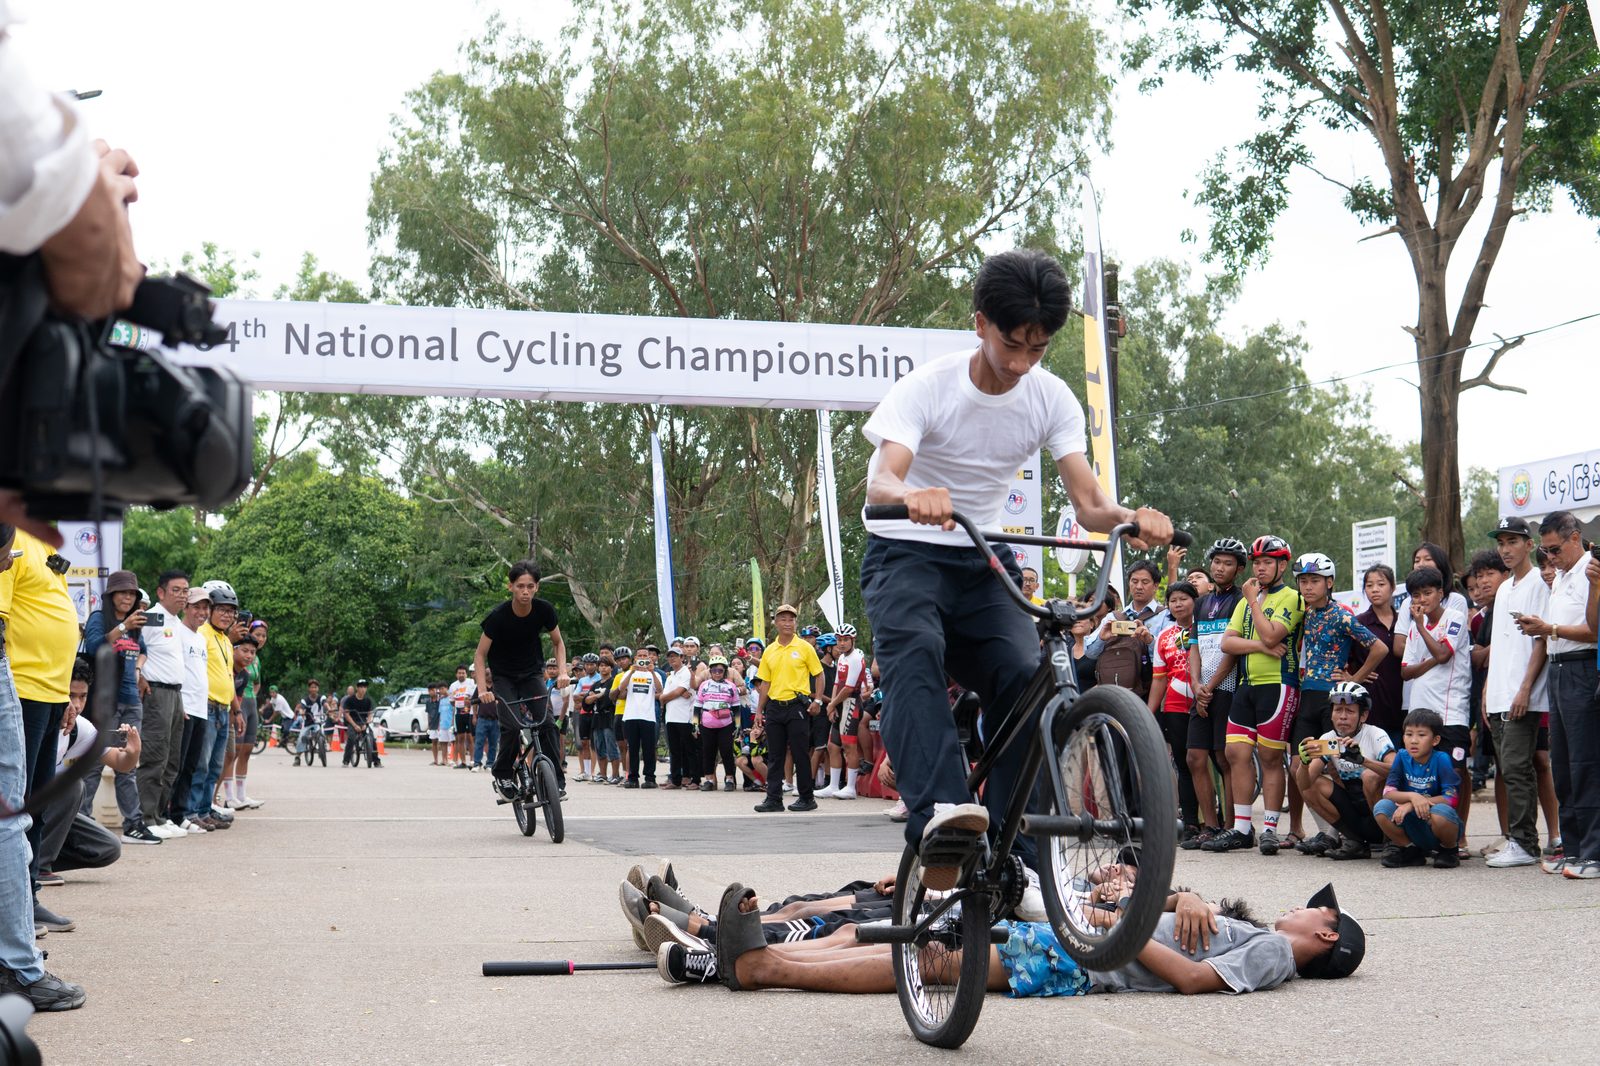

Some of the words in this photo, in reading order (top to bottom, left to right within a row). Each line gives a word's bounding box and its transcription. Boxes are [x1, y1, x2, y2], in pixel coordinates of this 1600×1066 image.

[193, 317, 267, 353] 4th
[285, 322, 459, 362] National
[476, 329, 623, 378] Cycling
[637, 335, 914, 383] Championship
[71, 568, 94, 576] MSP
